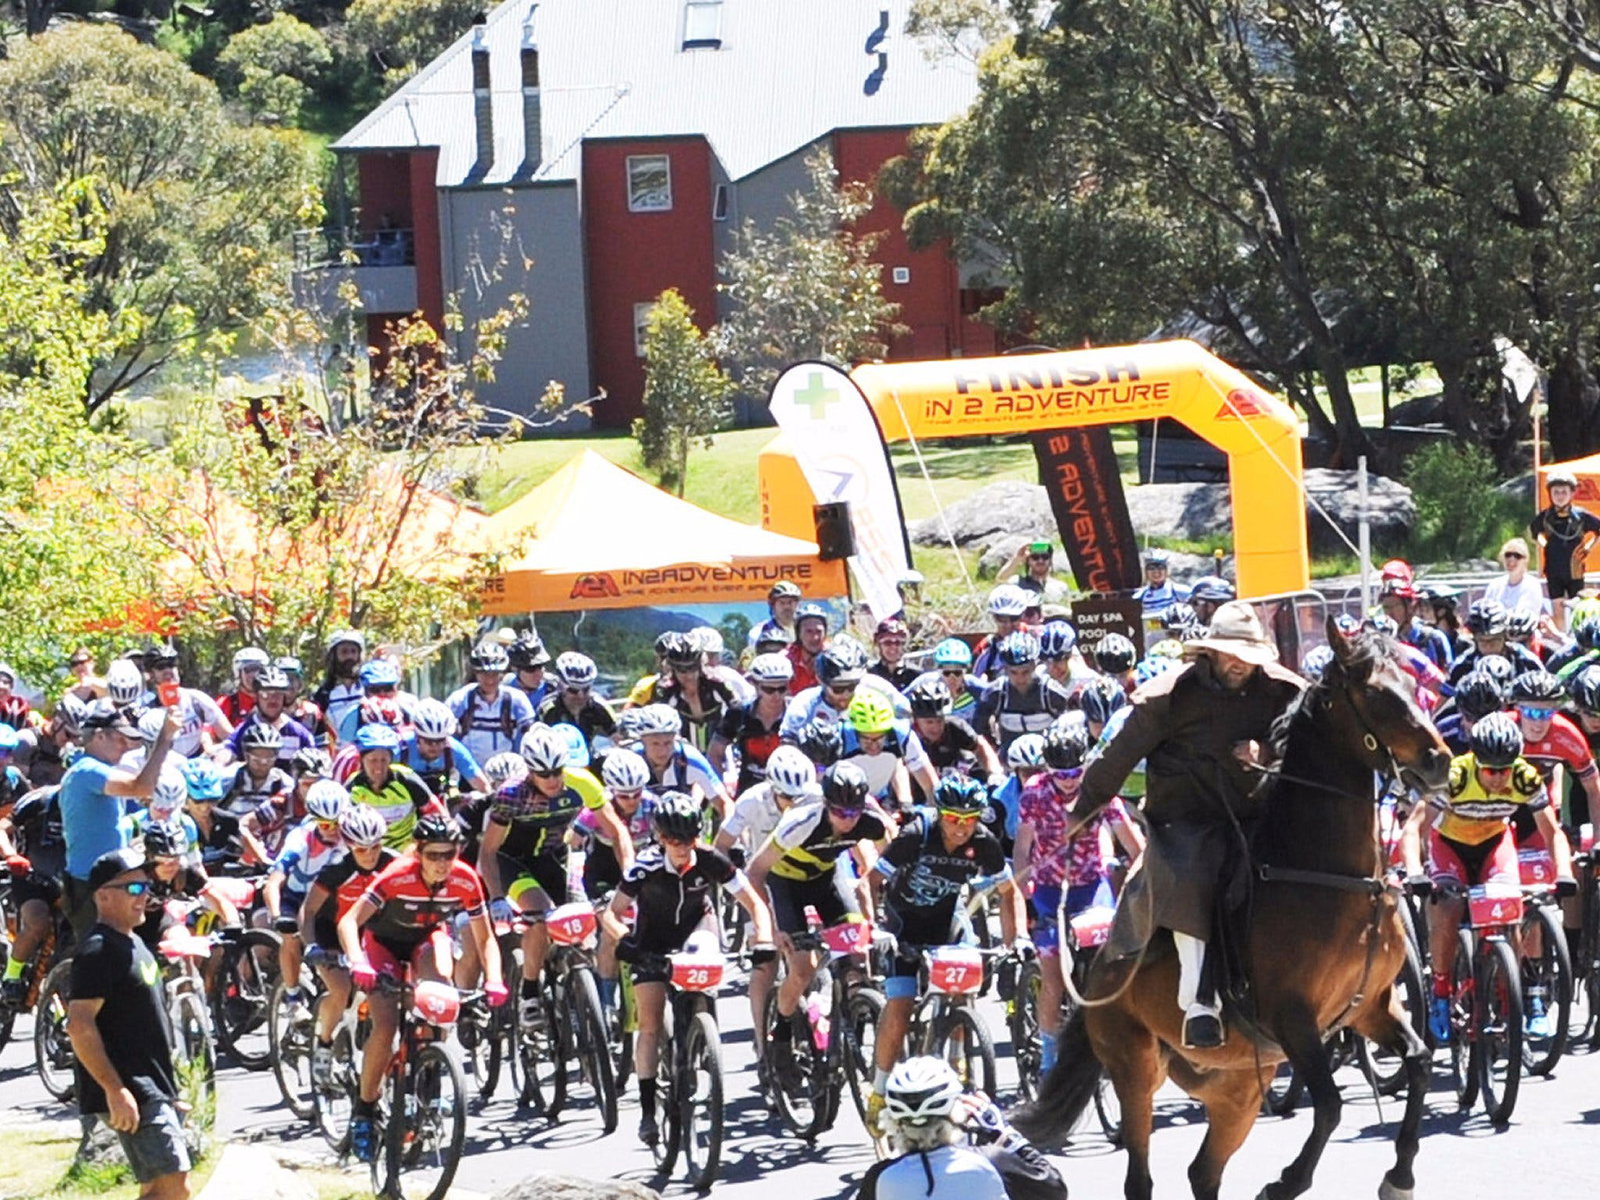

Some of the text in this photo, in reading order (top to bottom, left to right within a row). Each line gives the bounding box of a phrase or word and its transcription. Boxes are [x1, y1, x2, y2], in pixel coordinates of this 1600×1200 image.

[954, 361, 1141, 394] FINISH
[963, 398, 983, 415] 2
[994, 382, 1171, 415] ADVENTURE
[1048, 435, 1070, 455] 2
[1077, 612, 1124, 625] DAY SPA
[1491, 903, 1504, 919] 4
[562, 918, 583, 936] 18
[945, 967, 968, 984] 27
